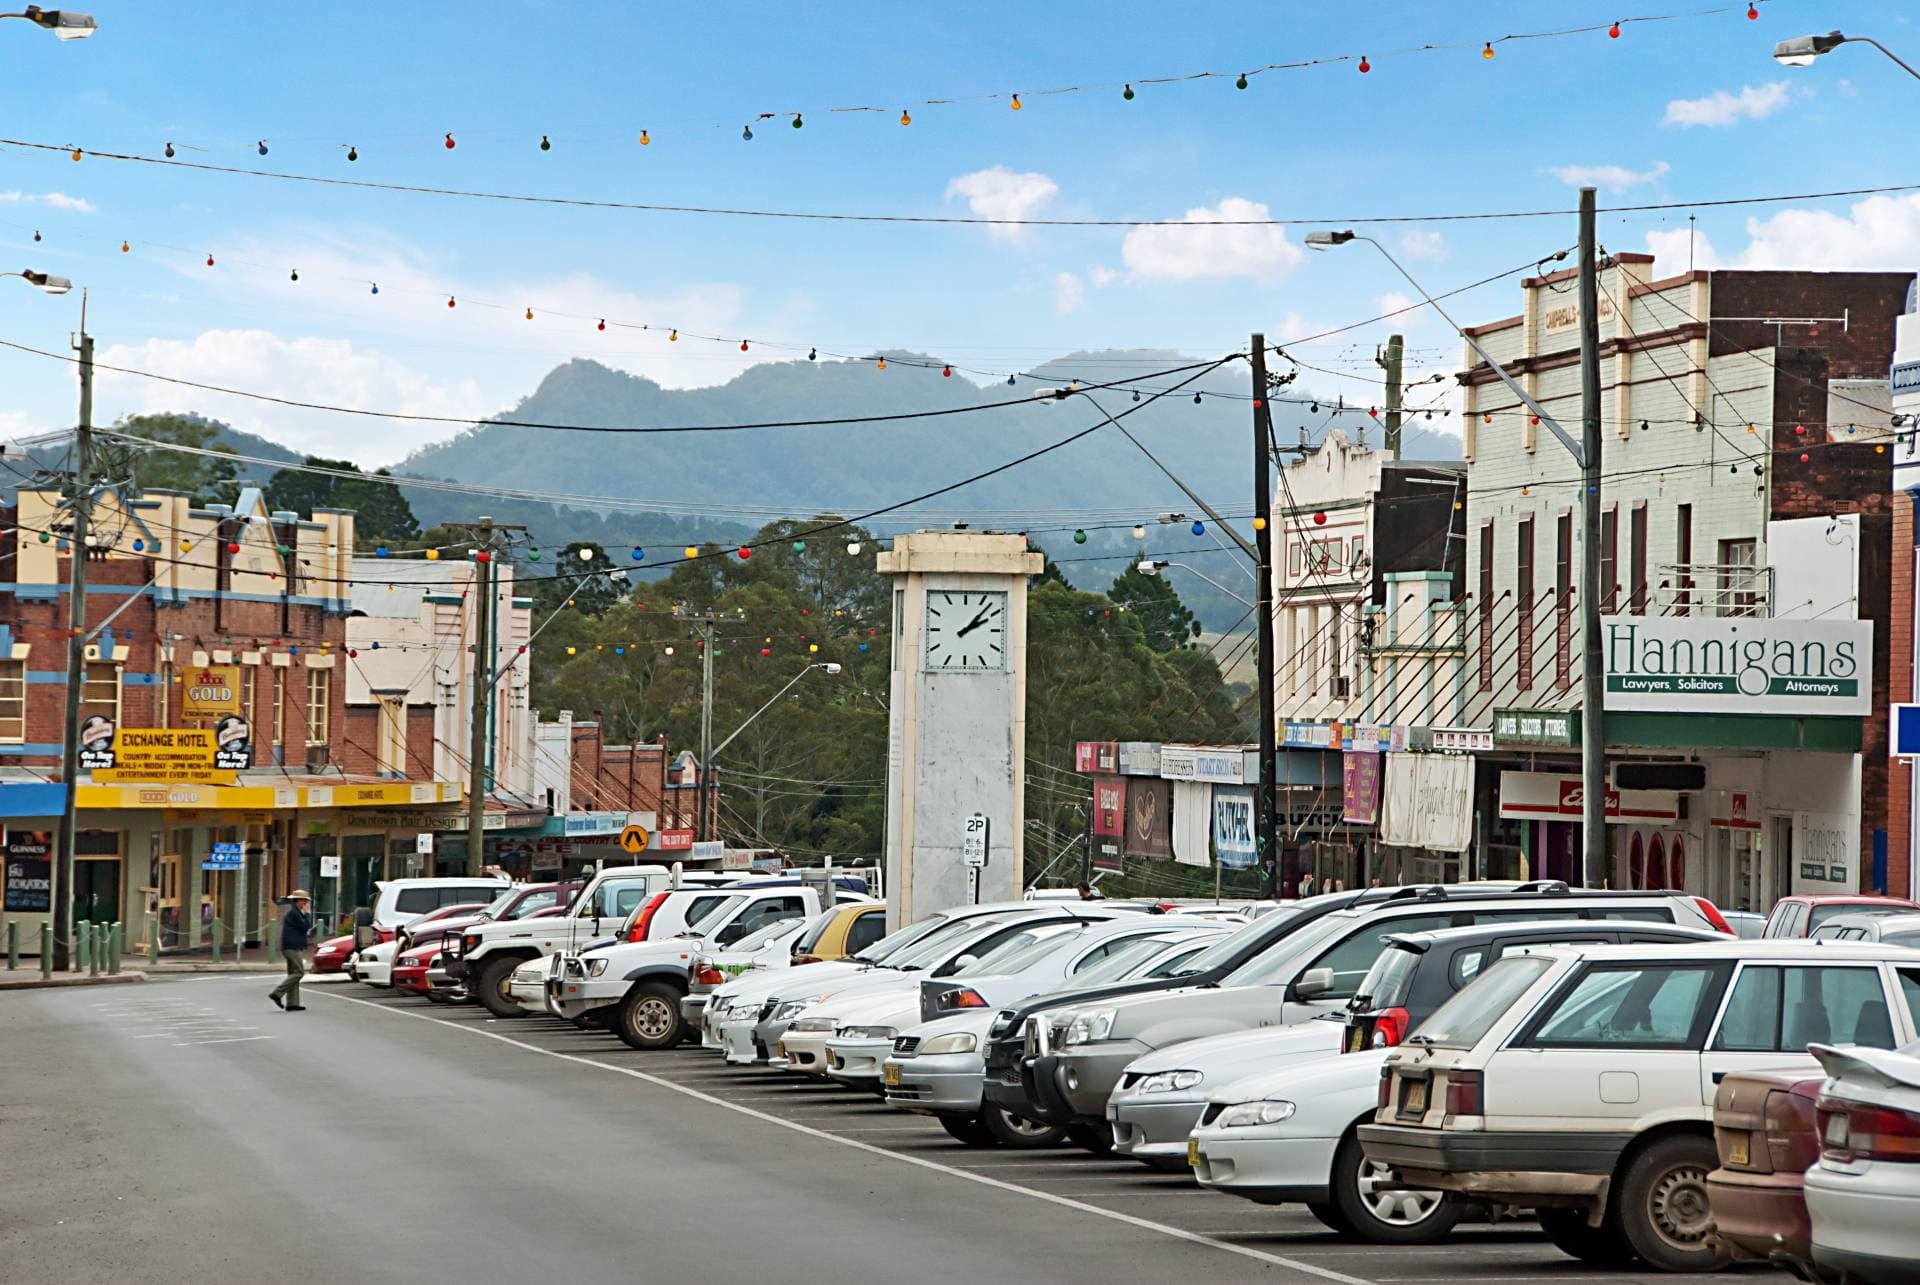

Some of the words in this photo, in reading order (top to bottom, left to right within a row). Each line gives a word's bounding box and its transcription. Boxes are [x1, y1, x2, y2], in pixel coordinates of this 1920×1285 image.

[1606, 624, 1857, 696] Hannigans
[1677, 678, 1724, 690] Solicitors
[1785, 680, 1839, 695] Attorneys
[189, 687, 232, 701] GOLD
[1499, 717, 1517, 735] LAWYERS
[122, 733, 174, 747] EXCHANGE
[177, 733, 208, 747] HOTEL
[80, 751, 96, 760] On
[96, 751, 114, 761] Tap
[123, 753, 152, 761] COUNTRY
[154, 753, 207, 761] ACCOMMODATION
[217, 751, 231, 760] On
[231, 751, 248, 761] Tap
[82, 759, 112, 769] Here!
[218, 759, 247, 769] Here!
[117, 771, 167, 779] ENTERTAINMENT
[169, 771, 189, 779] EVERY
[169, 792, 198, 802] GOLD
[346, 813, 398, 826] Downtown
[401, 813, 420, 826] Hair
[424, 815, 457, 829] Design
[967, 820, 984, 832] 2P
[1217, 801, 1252, 844] BUTCHER
[9, 844, 46, 853] GUINNESS
[496, 842, 572, 853] CAFE
